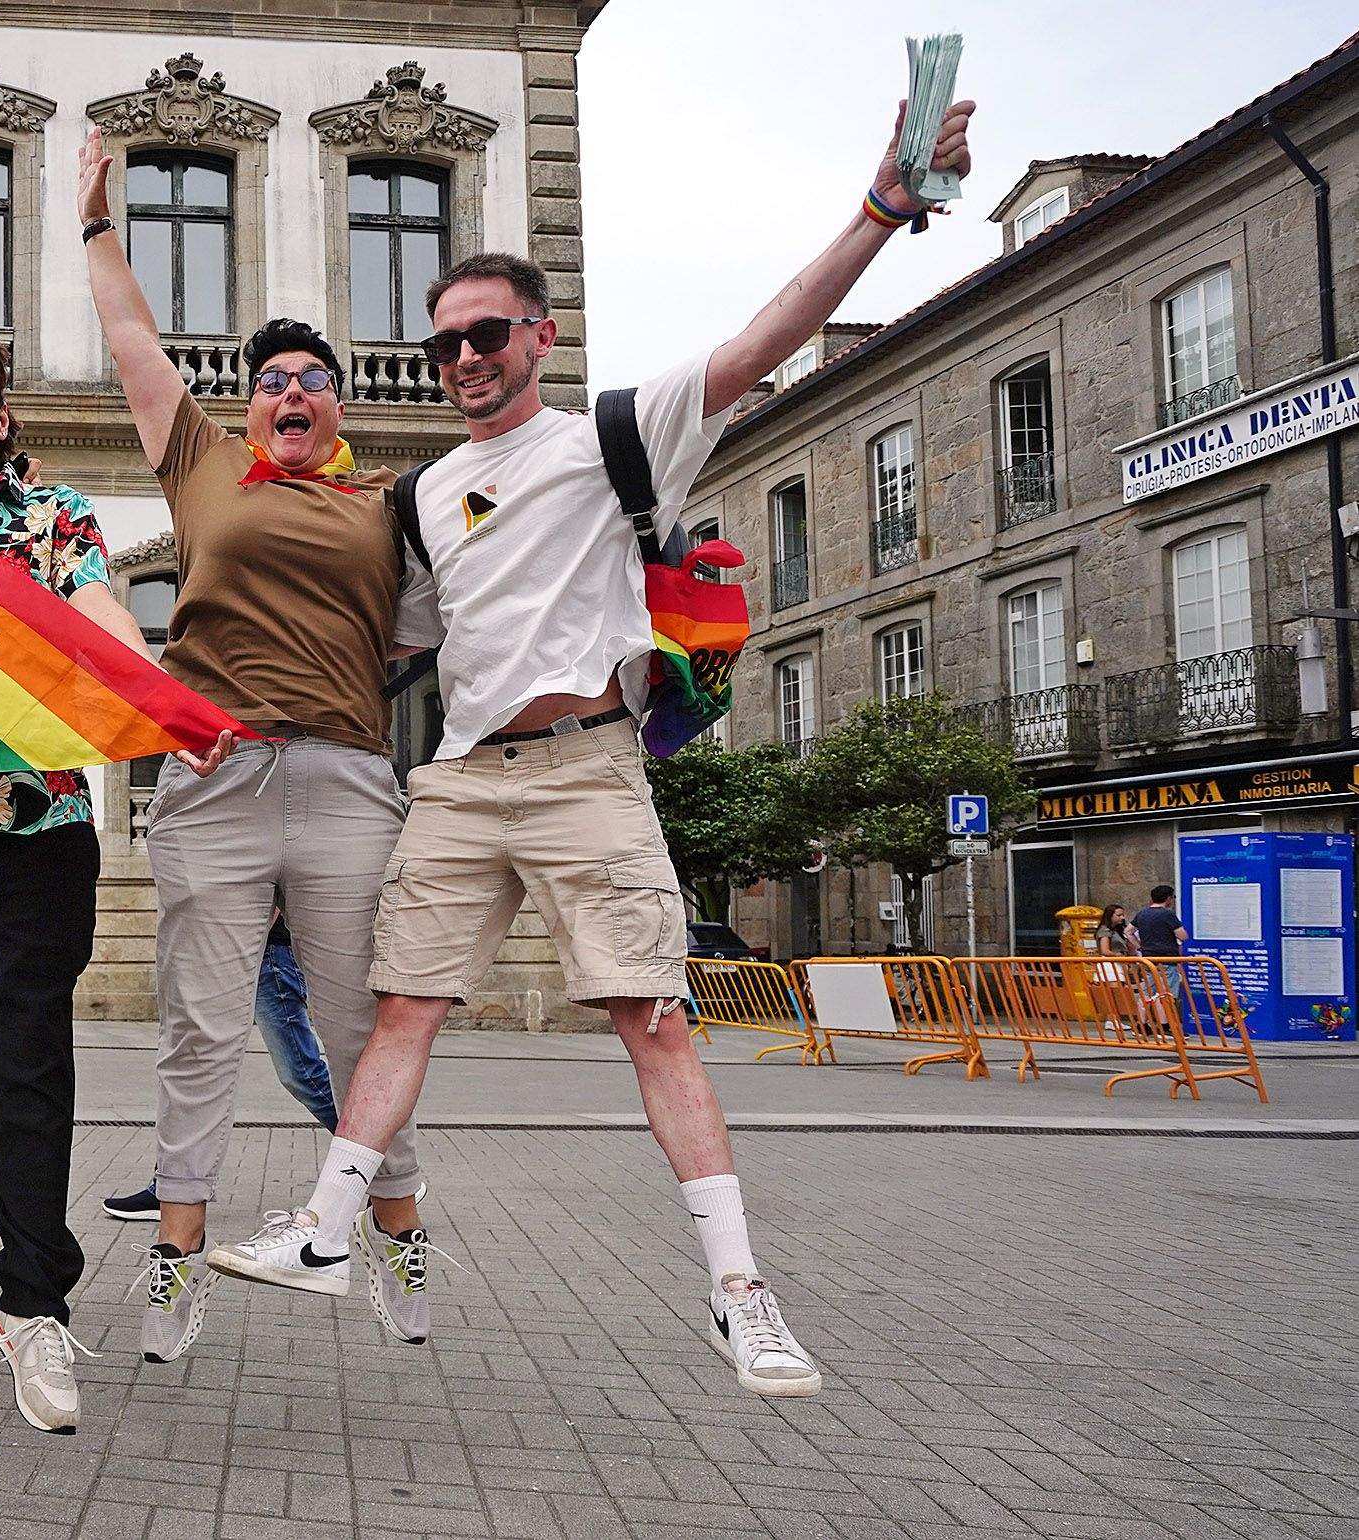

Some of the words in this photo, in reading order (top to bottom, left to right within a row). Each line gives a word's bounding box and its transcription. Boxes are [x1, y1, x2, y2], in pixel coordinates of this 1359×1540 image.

[1129, 424, 1233, 479] CLINICA
[1252, 769, 1311, 784] GESTION
[1041, 780, 1225, 819] MICHELENA
[1239, 782, 1332, 799] INMOBILIARIA
[958, 801, 980, 828] P
